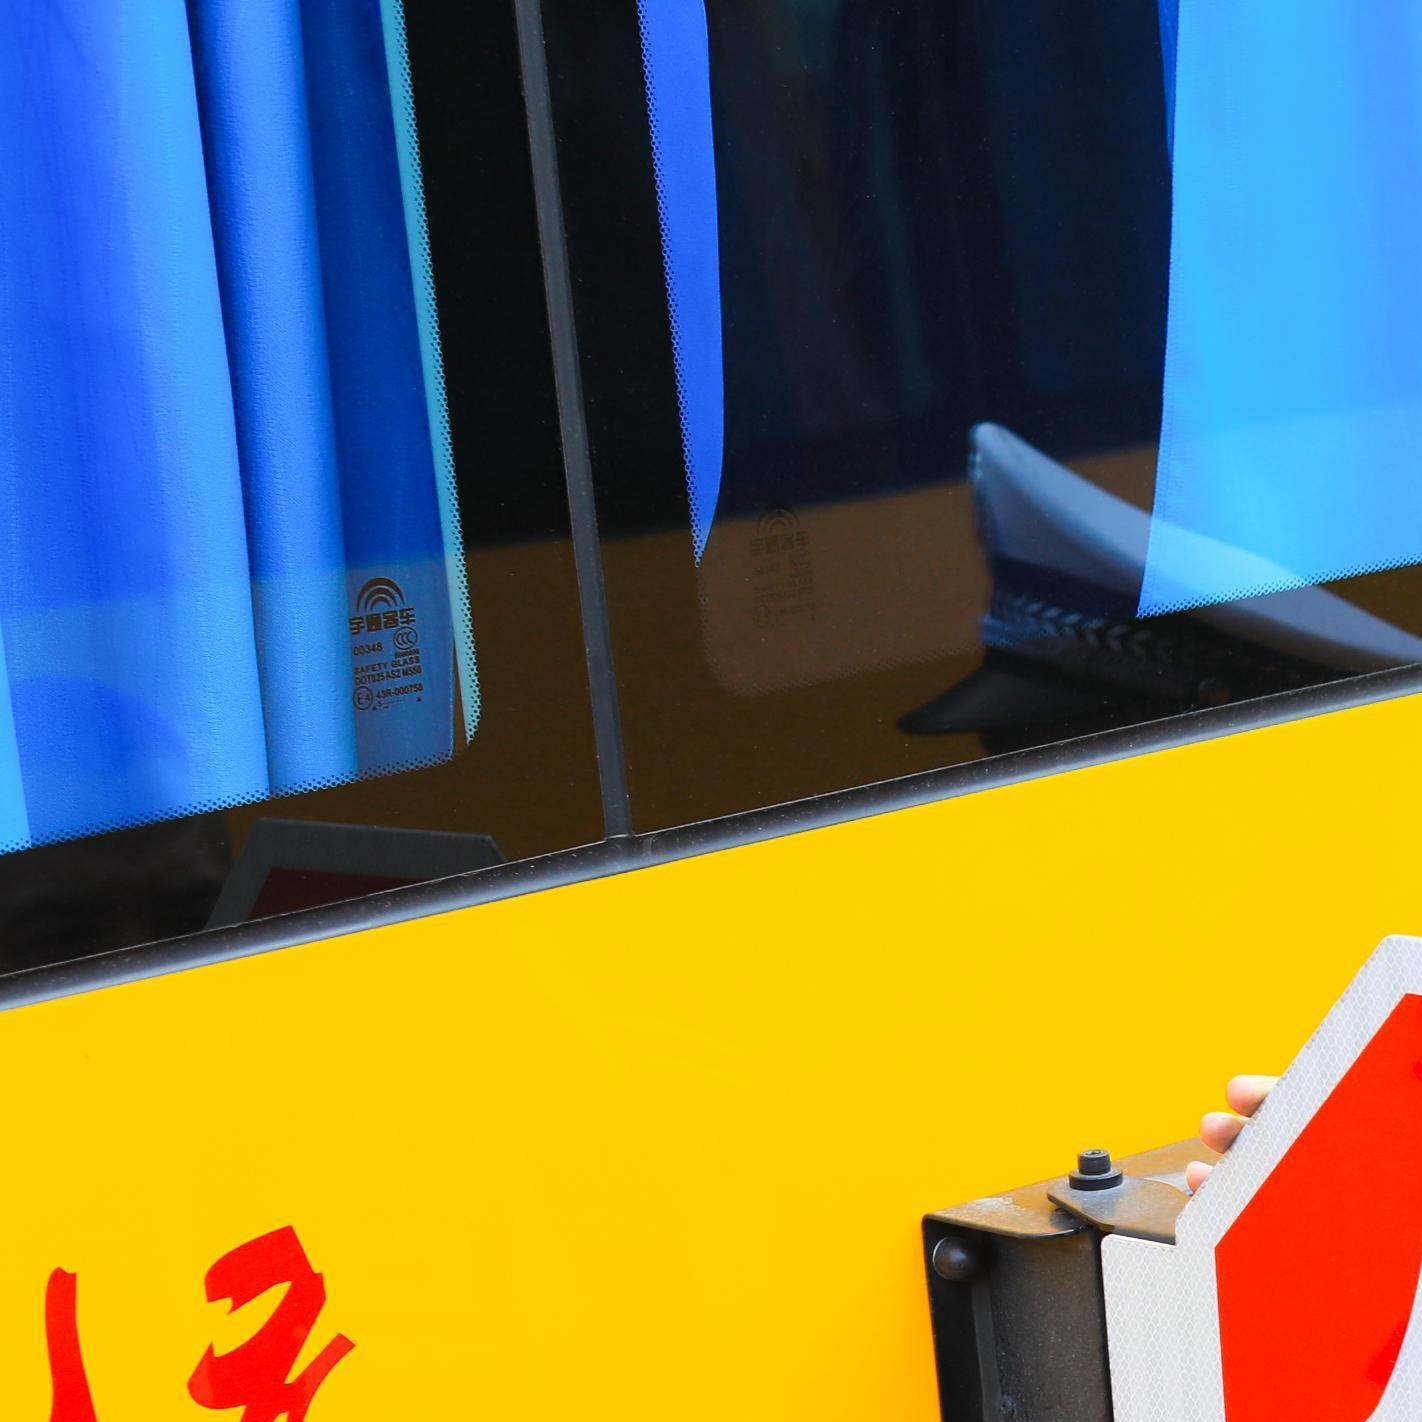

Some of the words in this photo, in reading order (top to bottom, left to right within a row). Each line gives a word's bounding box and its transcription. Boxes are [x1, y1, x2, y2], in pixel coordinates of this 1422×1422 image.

[349, 607, 417, 635] 宇通客车
[354, 662, 388, 675] SAFETY
[391, 656, 420, 668] GLASS
